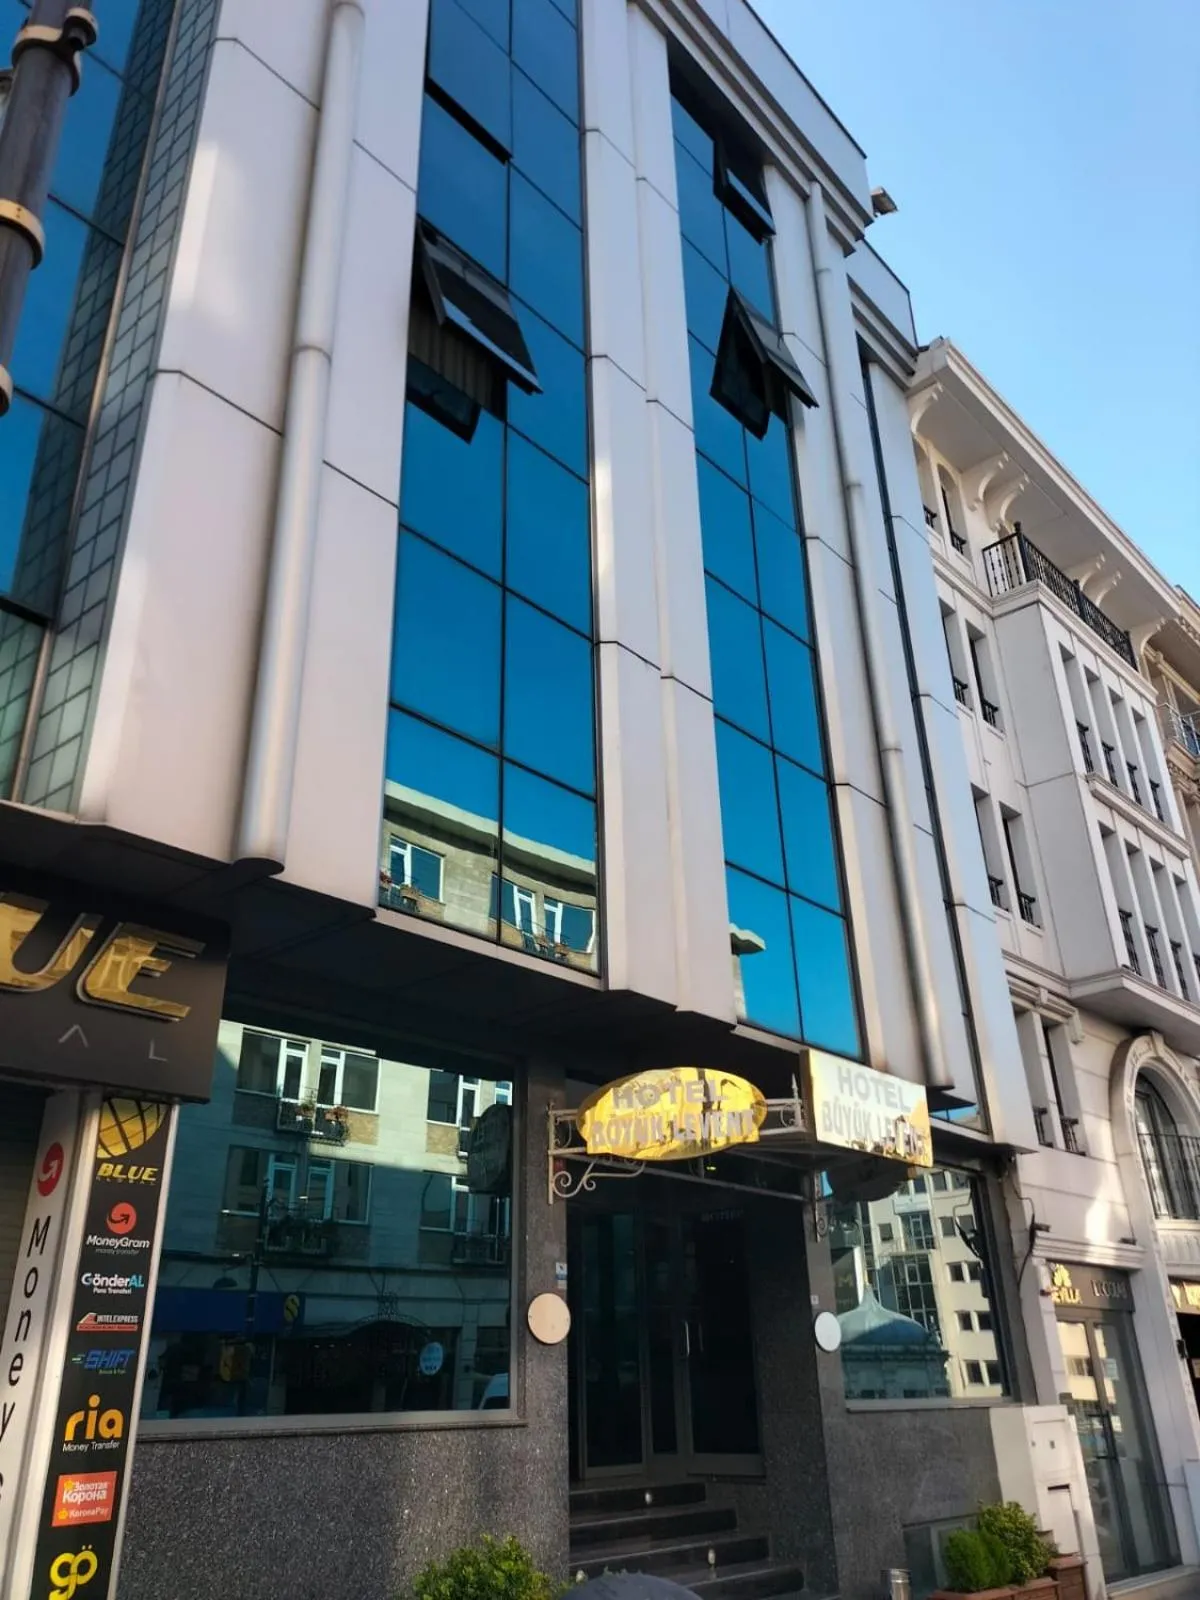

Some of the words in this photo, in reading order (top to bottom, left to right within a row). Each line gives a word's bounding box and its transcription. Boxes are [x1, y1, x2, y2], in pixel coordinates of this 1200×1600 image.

[612, 1078, 729, 1109] HOTEL
[837, 1065, 912, 1113] HOTEL
[821, 1095, 873, 1141] BÜYÜK
[97, 1162, 159, 1182] BLUE
[86, 1234, 151, 1249] MoneyGram
[81, 1272, 145, 1287] GönderAL
[64, 1394, 124, 1441] ria
[62, 1442, 90, 1453] Money
[91, 1439, 121, 1450] Transfer
[62, 1490, 107, 1505] Корона
